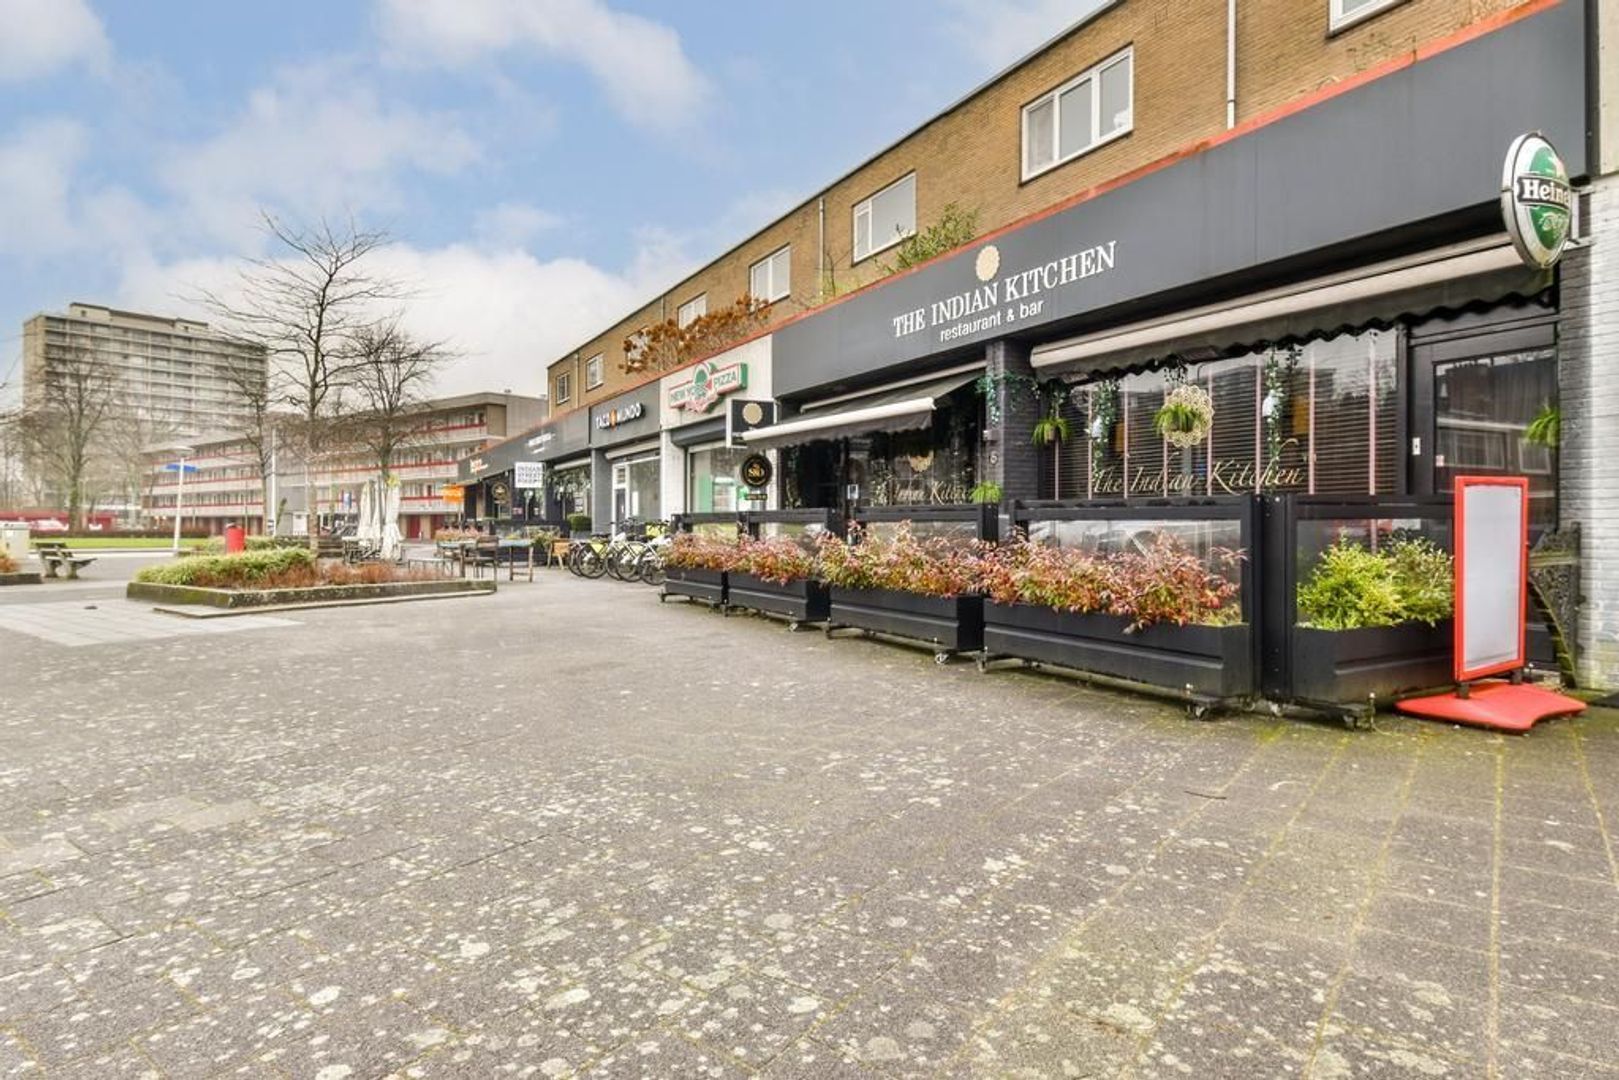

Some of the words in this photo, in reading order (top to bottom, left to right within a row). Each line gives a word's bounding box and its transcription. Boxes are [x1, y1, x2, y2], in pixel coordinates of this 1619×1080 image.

[892, 308, 926, 338] THE
[930, 283, 999, 326] INDIAN
[1004, 240, 1118, 303] KITCHEN
[940, 312, 1002, 343] restaurant
[1006, 309, 1015, 322] &
[1019, 300, 1044, 319] bar
[713, 371, 737, 388] PIZZA
[1093, 467, 1122, 493] The
[1129, 452, 1199, 492] Indian
[1208, 438, 1303, 496] Kitchen
